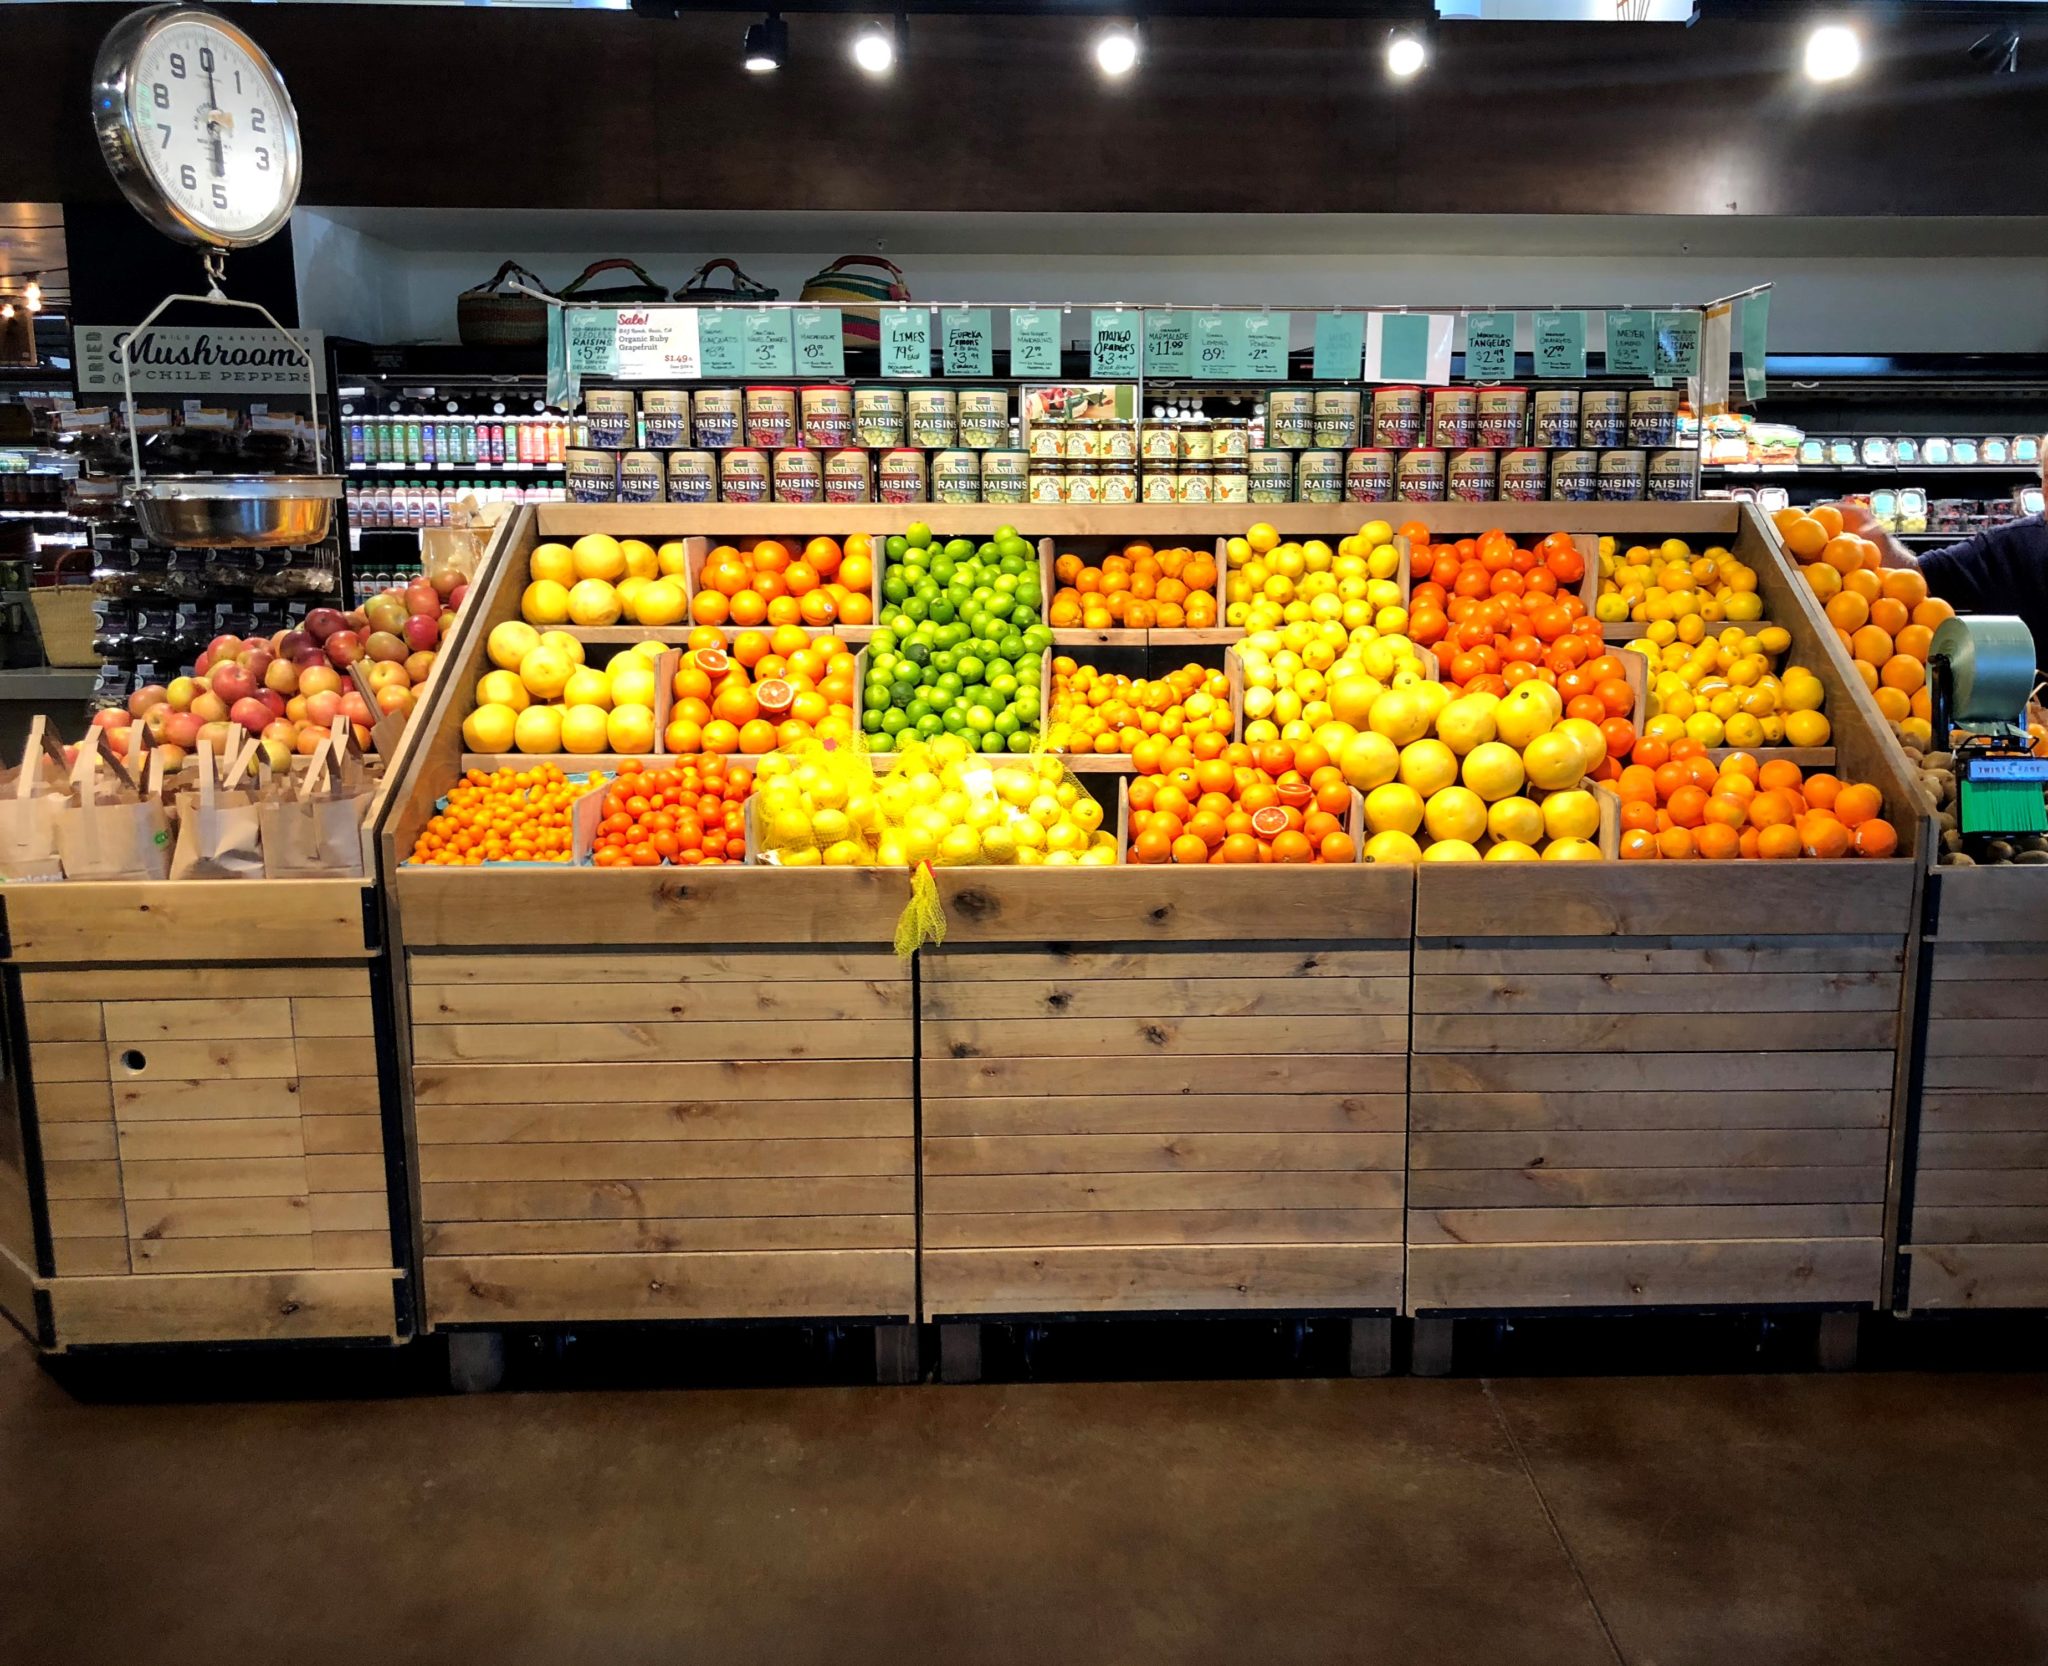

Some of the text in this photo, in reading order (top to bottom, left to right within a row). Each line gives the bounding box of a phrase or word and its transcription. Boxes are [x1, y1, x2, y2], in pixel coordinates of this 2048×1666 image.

[199, 47, 215, 74] 0
[170, 53, 186, 79] 9
[234, 70, 242, 95] 1
[153, 83, 170, 109] 8
[251, 107, 266, 133] 2
[157, 123, 172, 149] 7
[254, 147, 270, 171] 3
[180, 164, 197, 190] 6
[212, 184, 228, 209] 5
[618, 313, 649, 325] Sale!
[619, 334, 669, 344] Organic Ruby
[892, 330, 925, 343] LIMES
[1149, 333, 1190, 341] MARMALADE
[1617, 329, 1645, 339] MEYER
[572, 338, 613, 346] RAISINS
[1469, 338, 1511, 348] TANGELOS
[1657, 341, 1696, 350] RISINS
[108, 332, 311, 367] Mushrooms
[619, 343, 658, 352] Grapefruit
[1149, 340, 1184, 356] $11.99
[86, 331, 106, 384] DRIED
[664, 354, 688, 363] $1.49
[146, 370, 211, 381] CHILE
[220, 371, 311, 382] PEPPERS
[645, 419, 685, 429] AISINS
[747, 418, 792, 428] RAISINS
[806, 420, 851, 430] RAISINS
[858, 417, 903, 427] RAISINS
[913, 419, 957, 429] RAISINS
[961, 418, 1008, 428] RAISINS
[1275, 419, 1313, 429] RAISIN
[1438, 420, 1475, 429] RAISIN
[1478, 420, 1522, 429] RAISINS
[1540, 419, 1578, 429] RAISIN
[1586, 419, 1625, 429] RAISIN
[1630, 418, 1676, 428] RAISINS
[568, 480, 614, 490] RAISINS
[622, 480, 660, 489] AISINS
[723, 480, 766, 490] RAISINS
[776, 479, 820, 488] RAISINS
[825, 480, 865, 490] AISINS
[938, 480, 980, 489] RAISINS
[984, 480, 1028, 489] RAISINS
[1248, 480, 1292, 489] RAISINS
[1304, 480, 1342, 489] RAISIN
[1347, 479, 1392, 488] RAISINS
[1400, 480, 1444, 490] RAISINS
[1451, 479, 1495, 488] RAISINS
[1503, 480, 1546, 489] RAISINS
[1556, 479, 1596, 488] RAISIN
[1649, 480, 1694, 489] RAISINS
